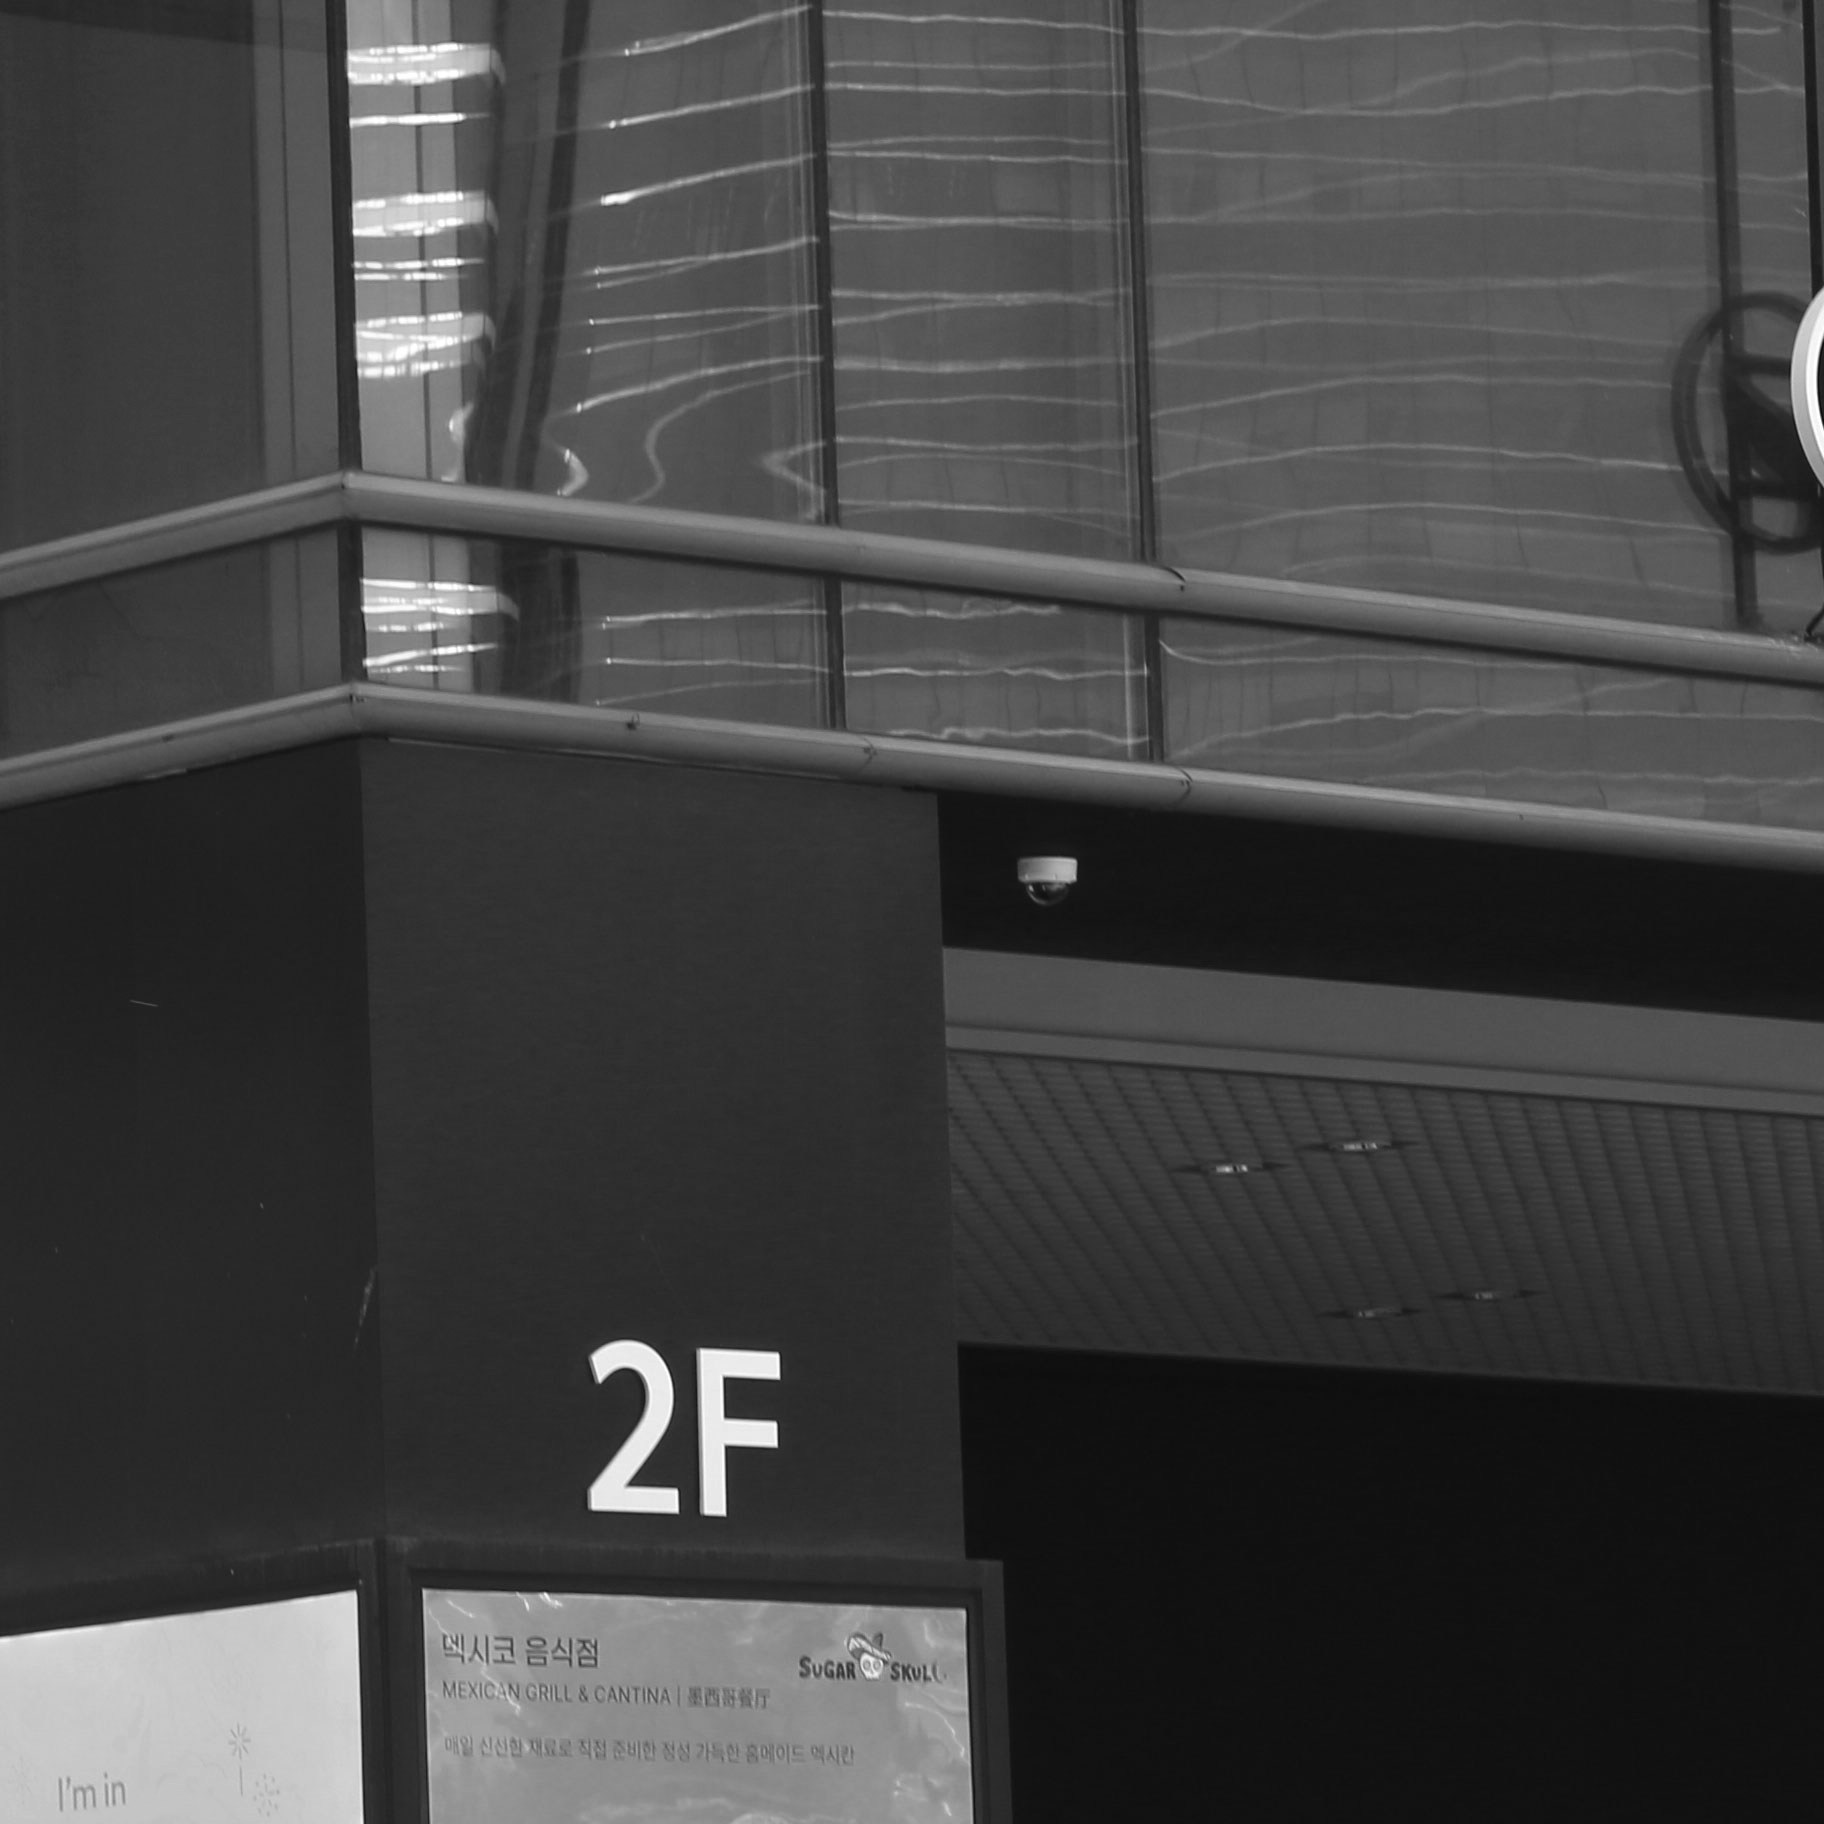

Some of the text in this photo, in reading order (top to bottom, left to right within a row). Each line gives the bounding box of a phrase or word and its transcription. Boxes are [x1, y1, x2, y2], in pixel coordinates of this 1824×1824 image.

[585, 1338, 781, 1518] 2F
[525, 1635, 599, 1669] 음식점
[799, 1656, 857, 1682] SUGAR
[442, 1680, 672, 1706] MEXICAN GRILL & CANTINA
[444, 1735, 474, 1758] 매일
[57, 1771, 127, 1812] I'm in
